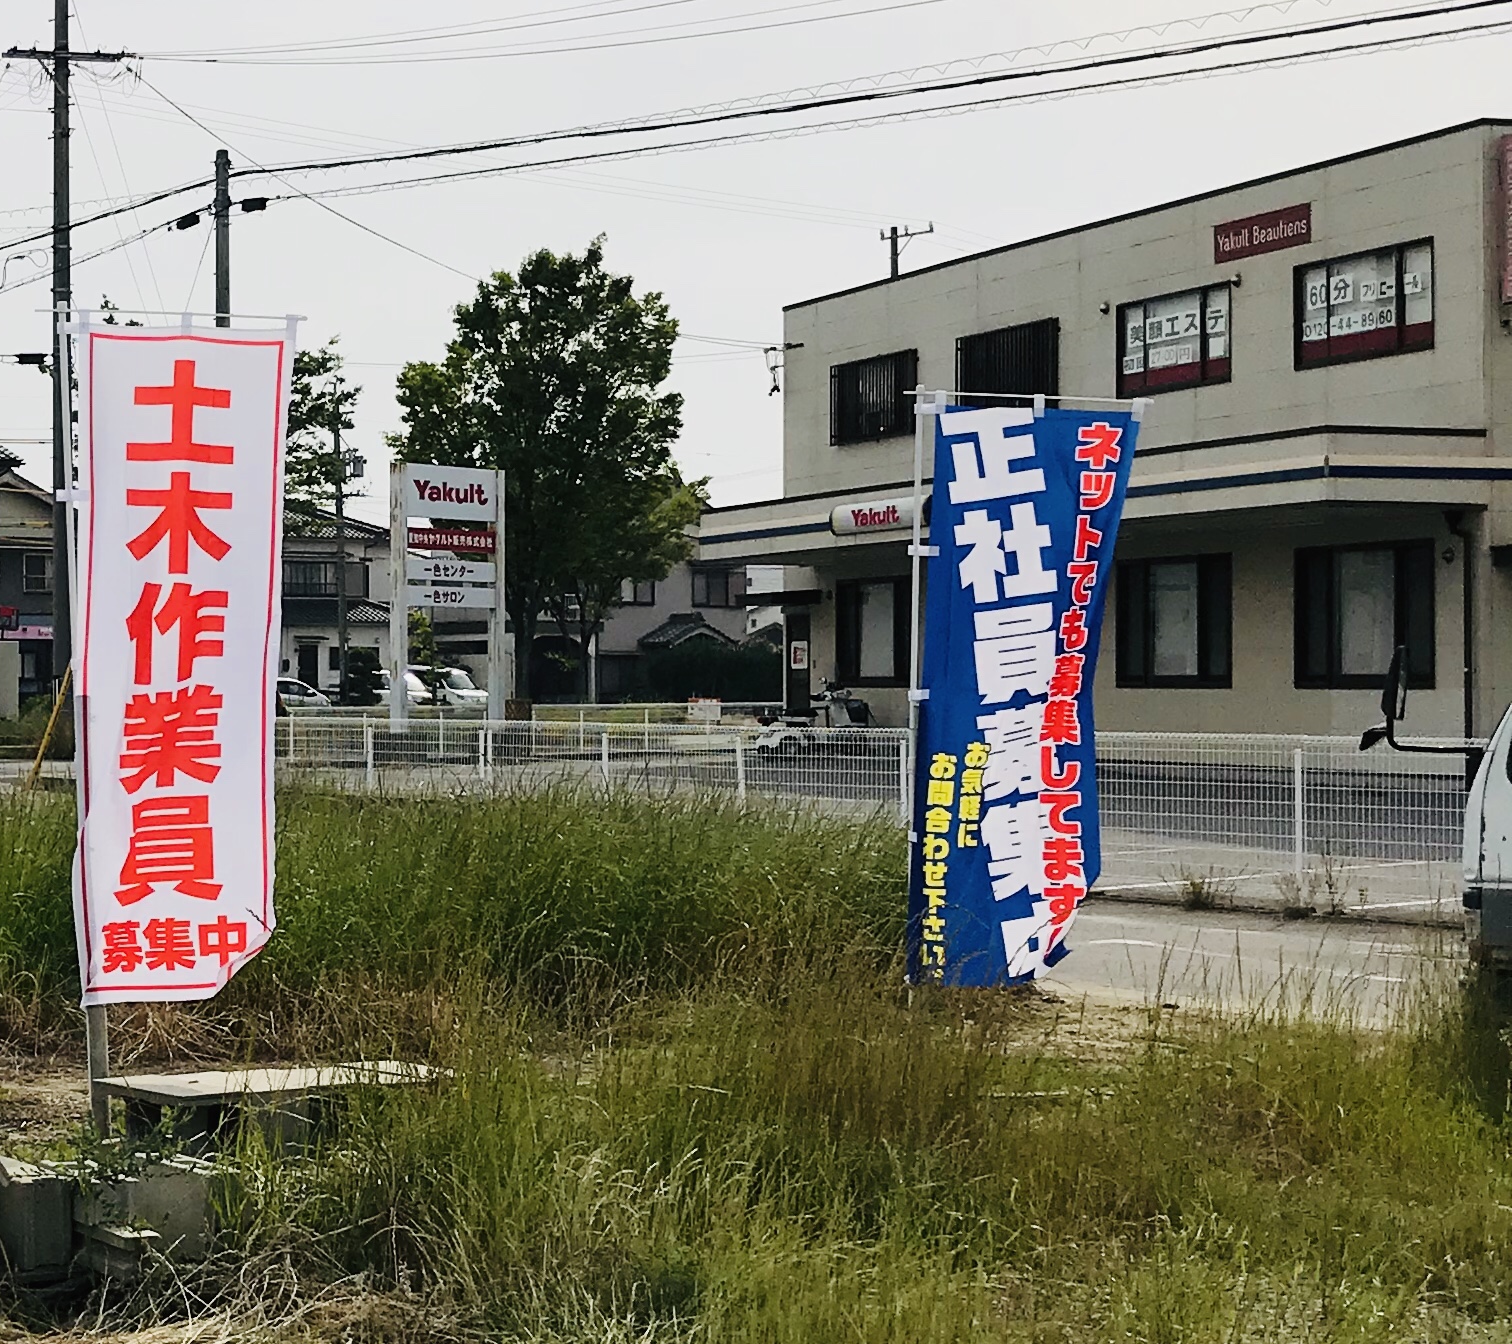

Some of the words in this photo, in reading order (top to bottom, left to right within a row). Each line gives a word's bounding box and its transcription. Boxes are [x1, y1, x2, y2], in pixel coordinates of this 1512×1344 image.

[1217, 229, 1249, 253] Yakult
[1252, 219, 1308, 245] Beautiens
[412, 479, 489, 506] Yakult
[851, 504, 899, 527] Yakult
[424, 563, 475, 578] 一色センター
[424, 590, 466, 604] 一色サロン
[113, 359, 234, 906] 土木作業員
[957, 741, 992, 848] お気軽に
[101, 914, 248, 974] 募集中
